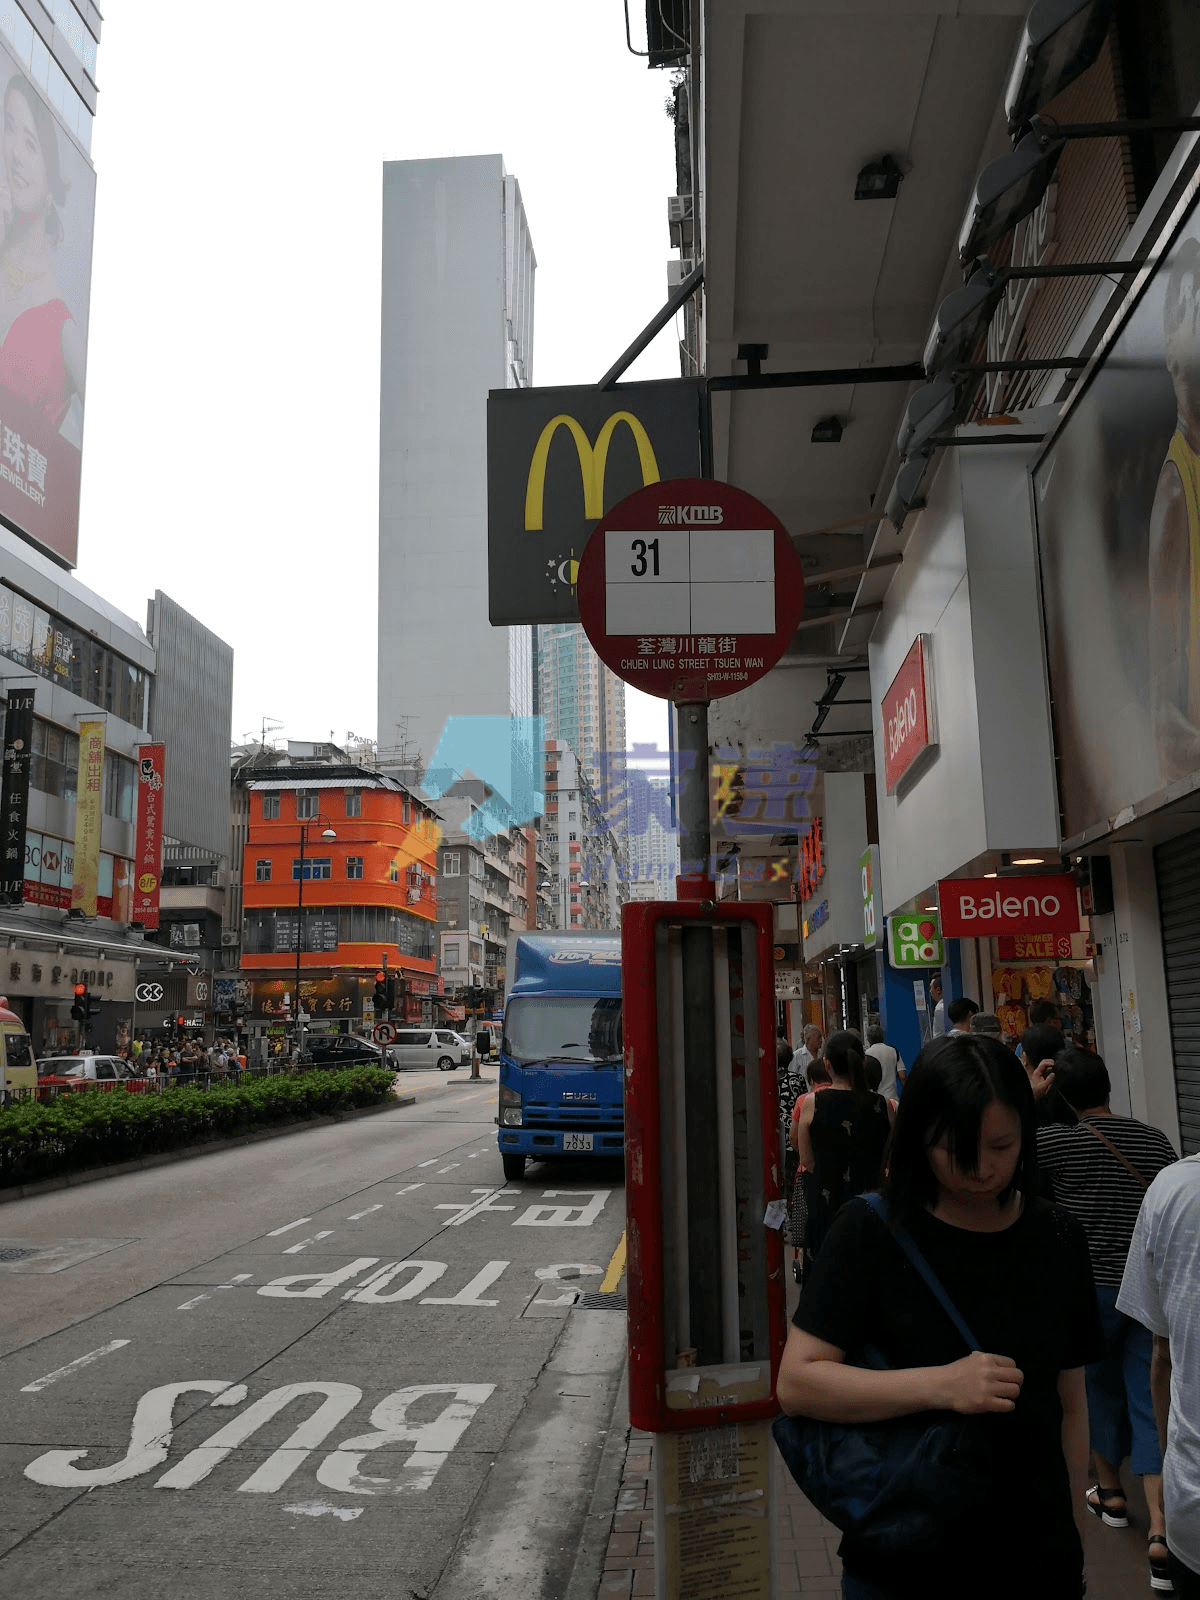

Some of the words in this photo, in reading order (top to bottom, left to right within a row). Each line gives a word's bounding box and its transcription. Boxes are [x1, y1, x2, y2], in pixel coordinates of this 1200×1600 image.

[677, 505, 724, 524] KMB
[631, 539, 660, 577] 31
[637, 637, 737, 655] 荃灣川龍街
[621, 659, 649, 670] CHUEN
[653, 659, 675, 669] LUNG
[679, 658, 710, 669] STREET
[714, 658, 741, 669] TSUEN
[744, 657, 764, 668] WAN
[8, 698, 33, 711] 11/F
[888, 687, 917, 760] Baleno
[6, 793, 22, 859] 任食火鍋
[960, 892, 1060, 920] Baleno
[1015, 942, 1054, 957] SALE
[562, 1092, 597, 1101] ISUZU
[565, 1141, 592, 1150] 7033
[571, 1134, 586, 1142] NJ
[23, 1380, 498, 1495] BUS
